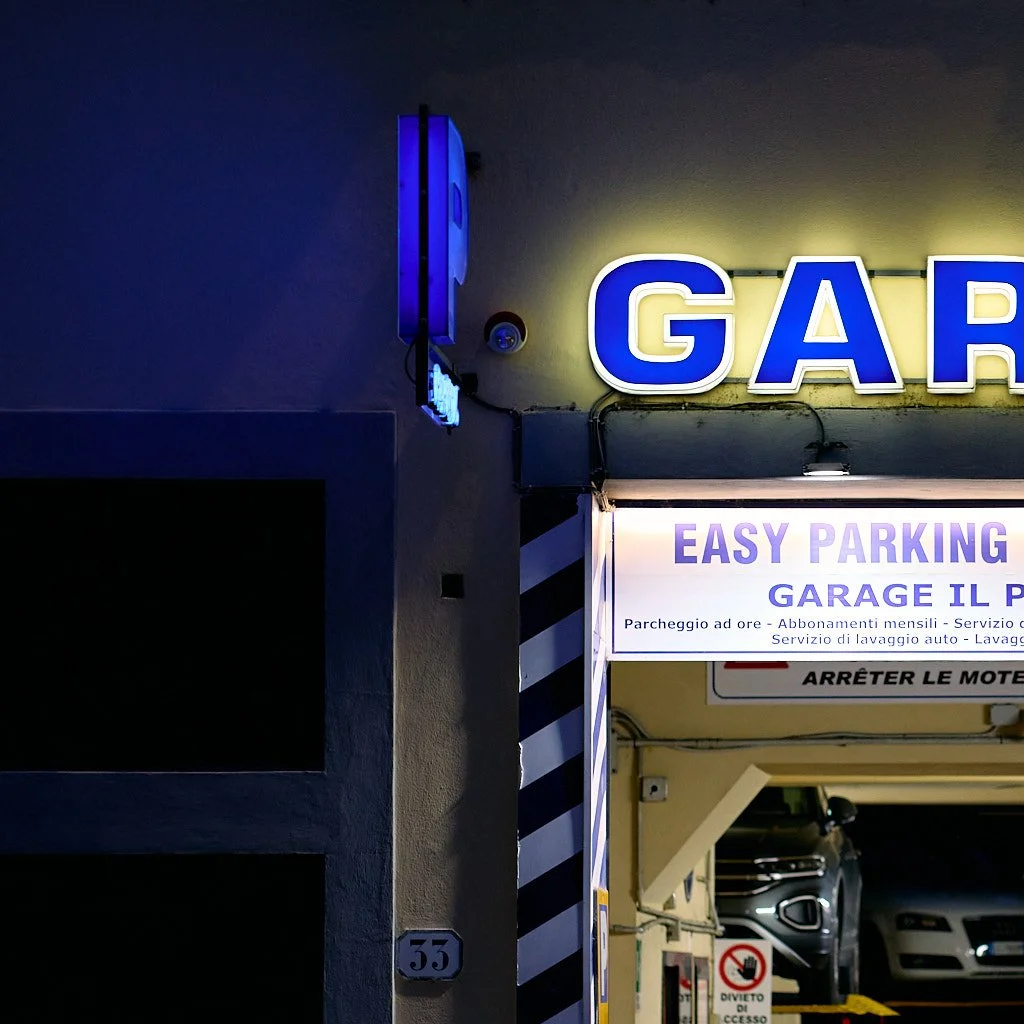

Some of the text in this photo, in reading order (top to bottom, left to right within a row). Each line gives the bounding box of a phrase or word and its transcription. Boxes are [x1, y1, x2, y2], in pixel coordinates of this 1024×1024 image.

[673, 522, 789, 565] EASY
[809, 522, 1009, 565] PARKING
[768, 583, 933, 608] GARAGE
[949, 583, 991, 608] IL
[624, 618, 709, 632] Parcheggio
[713, 618, 732, 630] ad
[736, 620, 761, 630] ore
[778, 618, 878, 630] Abbonamenti
[884, 617, 937, 629] mensili
[954, 617, 1014, 629] Servizio
[771, 633, 832, 645] Servizio
[836, 633, 850, 645] di
[856, 633, 919, 648] lavaggio
[924, 634, 958, 645] auto
[802, 667, 916, 685] ARRÊTER
[922, 670, 953, 685] LE
[409, 939, 450, 971] 33
[720, 993, 765, 1002] DIVIETO
[736, 1004, 748, 1013] DI
[722, 1015, 768, 1024] CCESSO
